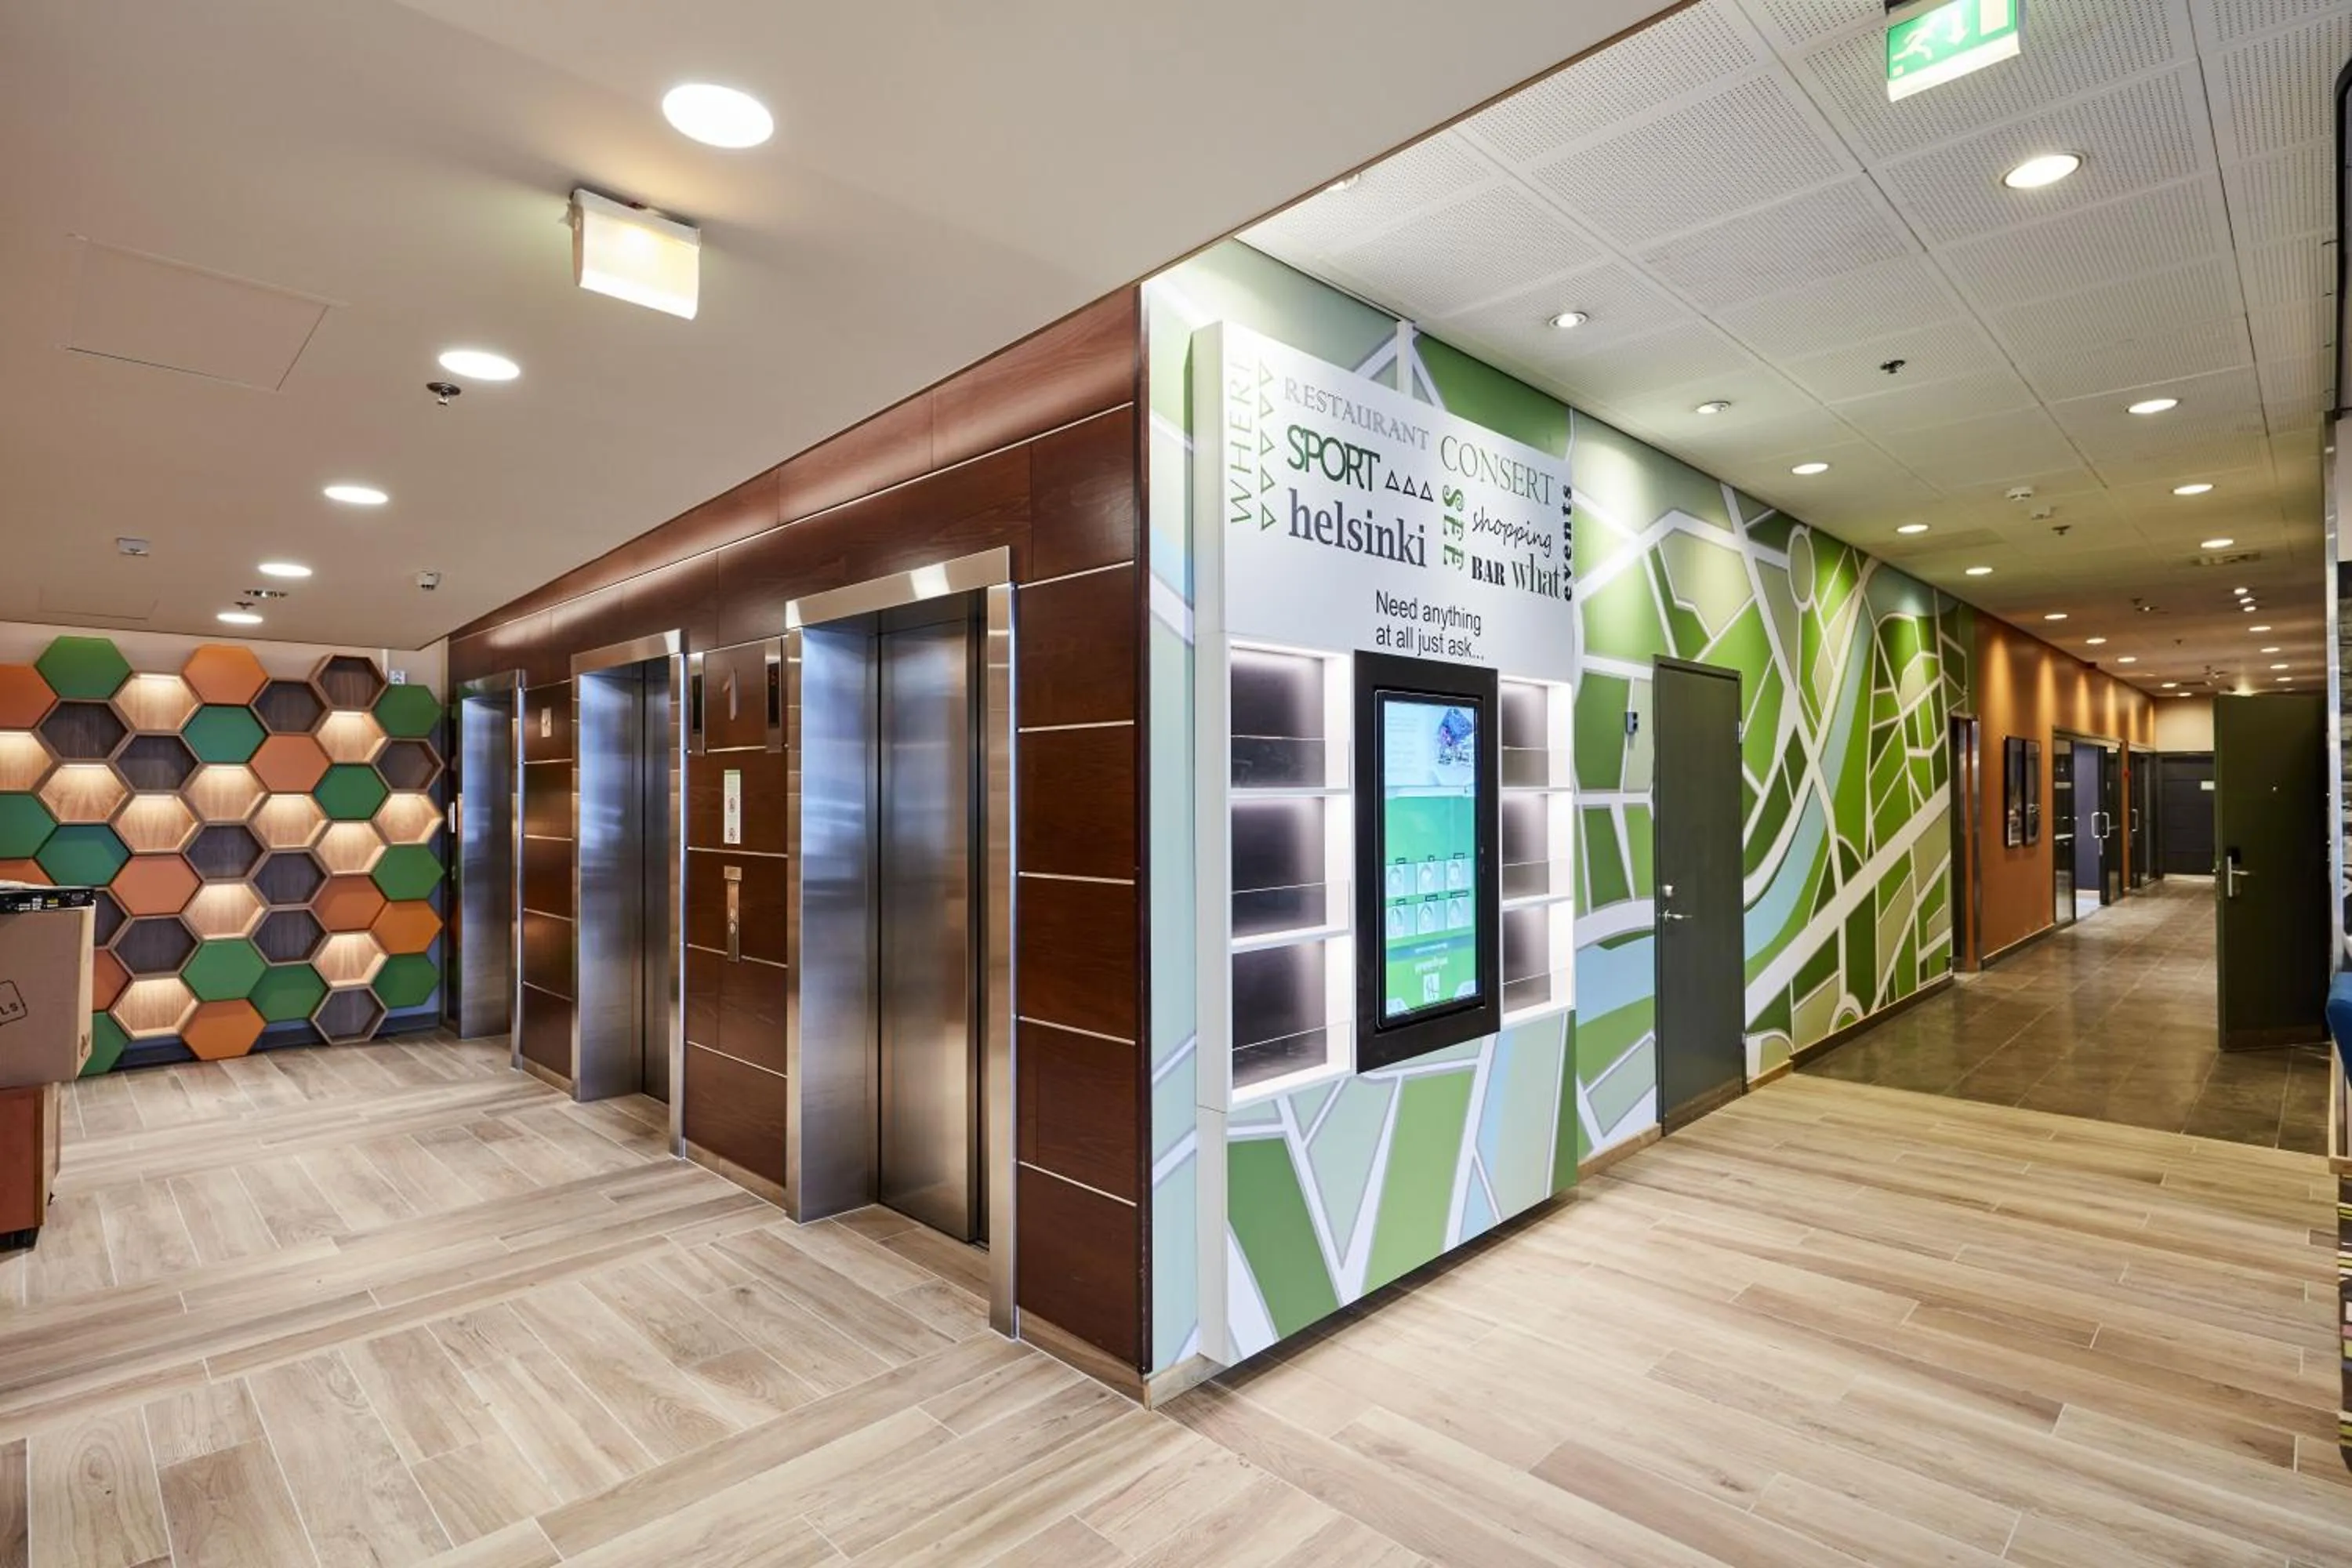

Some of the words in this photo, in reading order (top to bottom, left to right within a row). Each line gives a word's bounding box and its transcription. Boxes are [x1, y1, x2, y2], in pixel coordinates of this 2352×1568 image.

[1283, 376, 1430, 451] RESTAURANT
[1287, 423, 1381, 492] SPORT
[1440, 435, 1555, 506] CONSERT
[1287, 487, 1428, 568] helsinki
[1442, 484, 1465, 572] SEE
[1472, 506, 1552, 559] shopping
[1562, 484, 1573, 602] events
[1471, 554, 1506, 587] BAR
[1512, 553, 1561, 600] what
[1375, 589, 1418, 620] Need
[1422, 604, 1481, 637] anything
[1375, 623, 1392, 648] at
[1396, 625, 1414, 651] all
[1417, 627, 1444, 657] just
[1447, 635, 1485, 662] ask...
